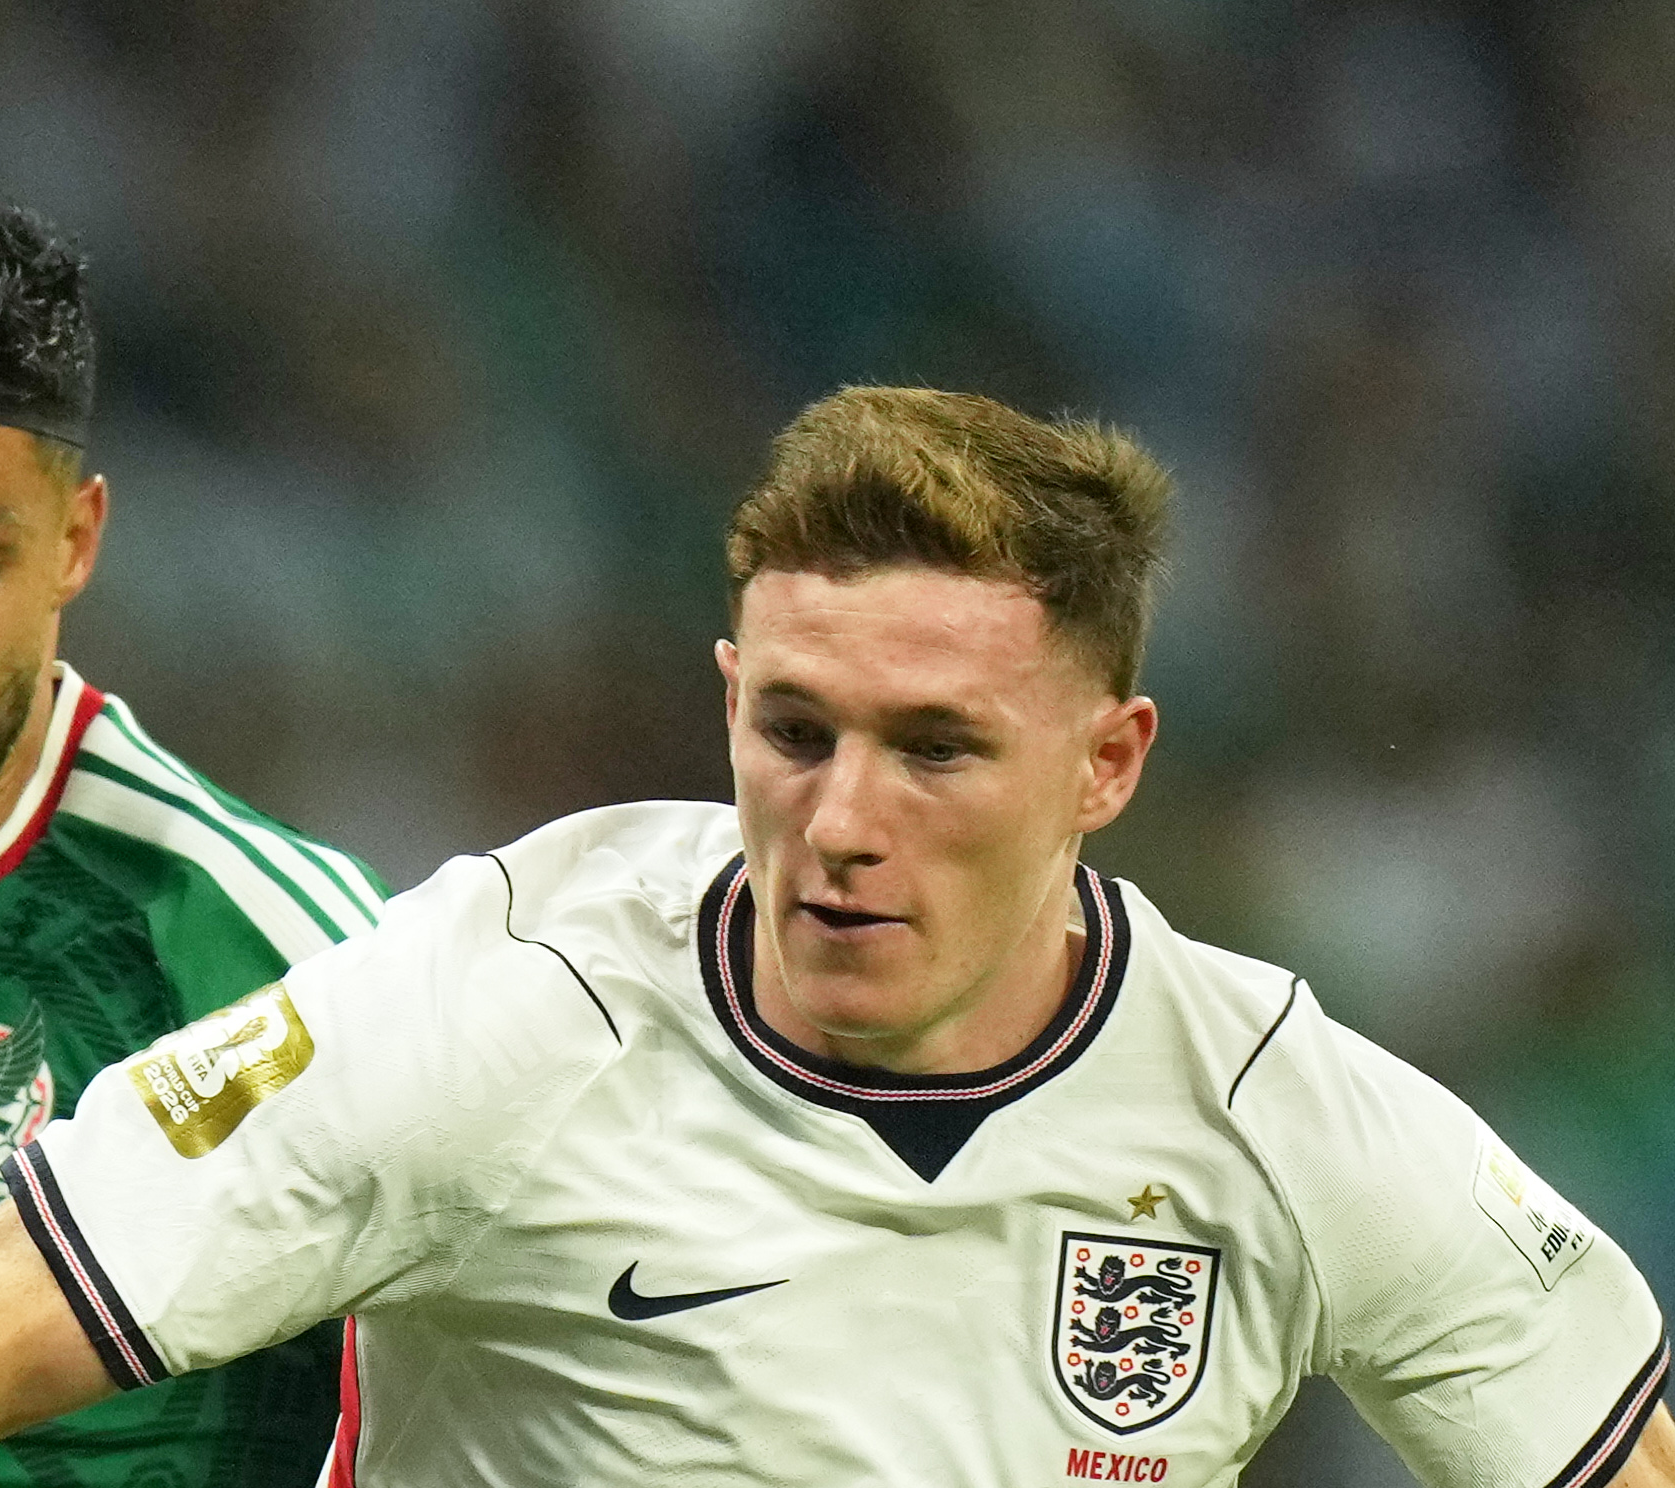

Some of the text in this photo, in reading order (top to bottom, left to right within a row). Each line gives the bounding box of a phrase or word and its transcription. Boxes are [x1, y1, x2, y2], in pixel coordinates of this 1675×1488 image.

[158, 1056, 200, 1114] WORLD CUP
[187, 1053, 209, 1082] FIFA
[142, 1063, 190, 1126] 2026
[1066, 1447, 1169, 1483] MEXICO
